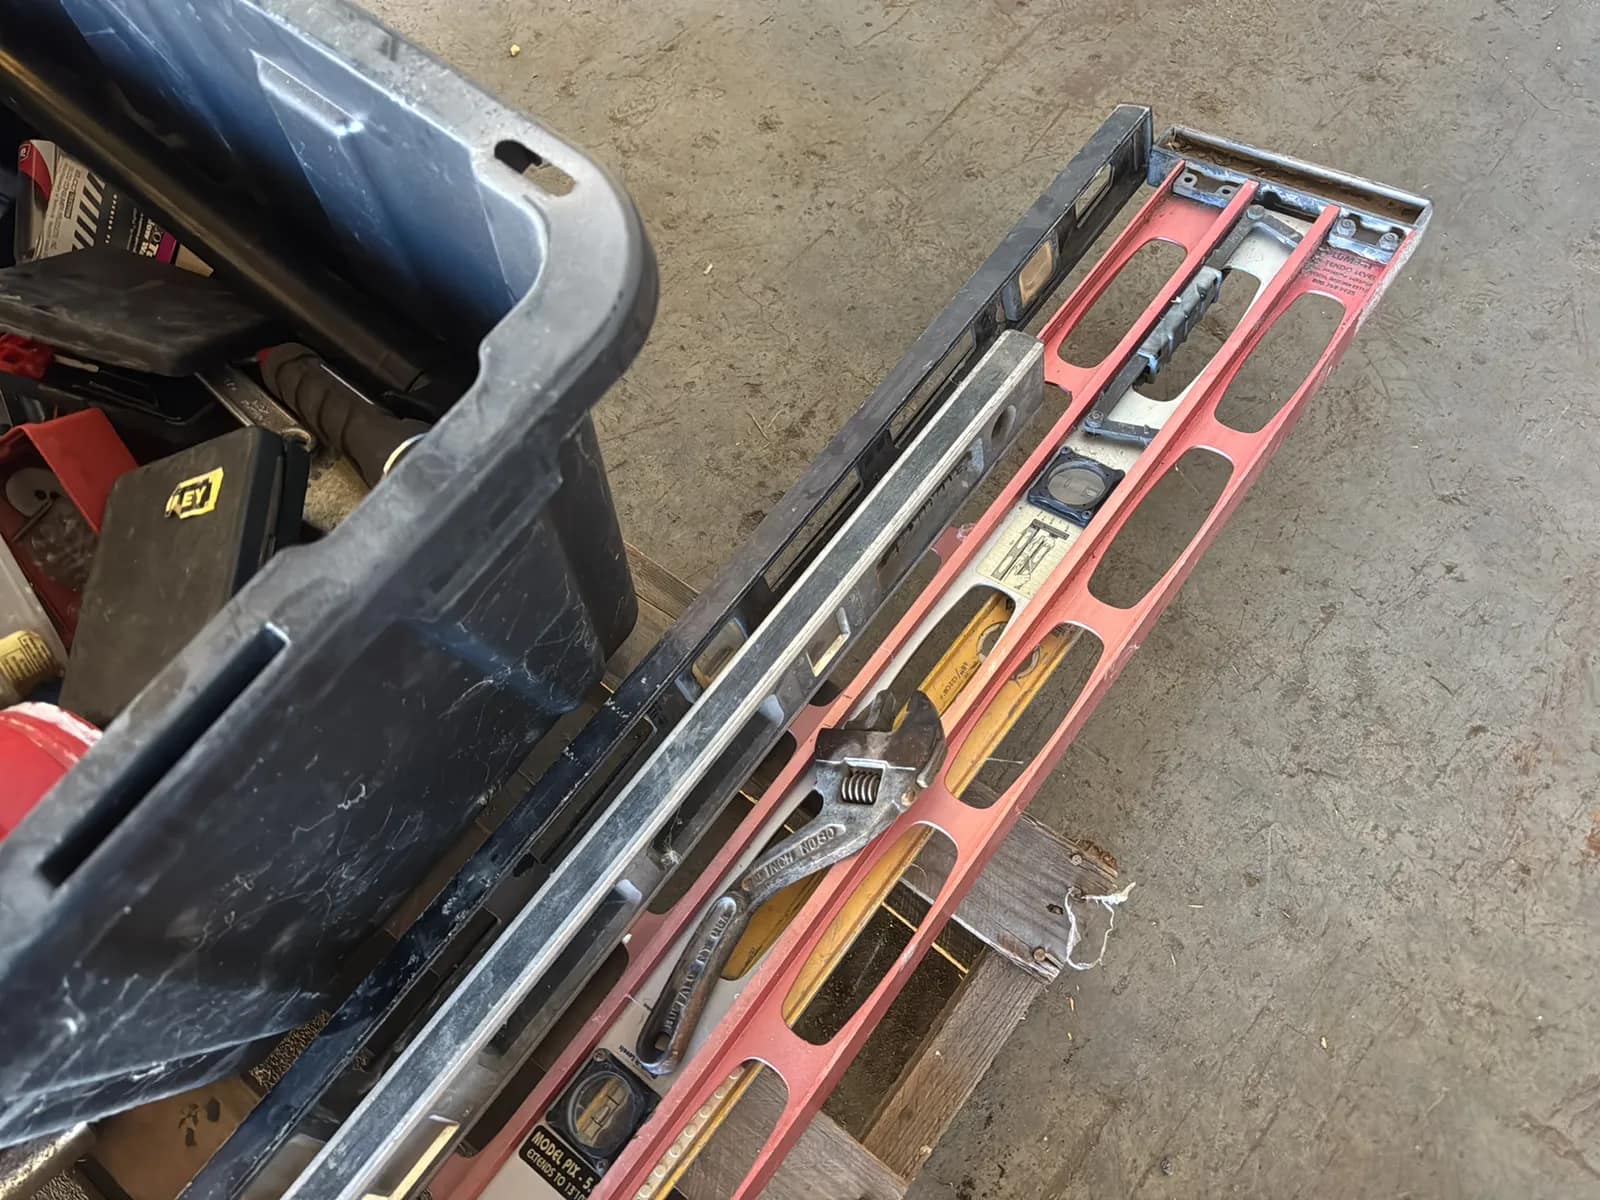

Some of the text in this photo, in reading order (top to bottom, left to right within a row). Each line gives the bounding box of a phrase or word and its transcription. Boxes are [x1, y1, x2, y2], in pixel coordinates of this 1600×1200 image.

[526, 1148, 556, 1177] EXTENDS
[553, 1172, 566, 1186] TO
[531, 1131, 564, 1165] MODEL
[561, 1158, 581, 1178] PIX
